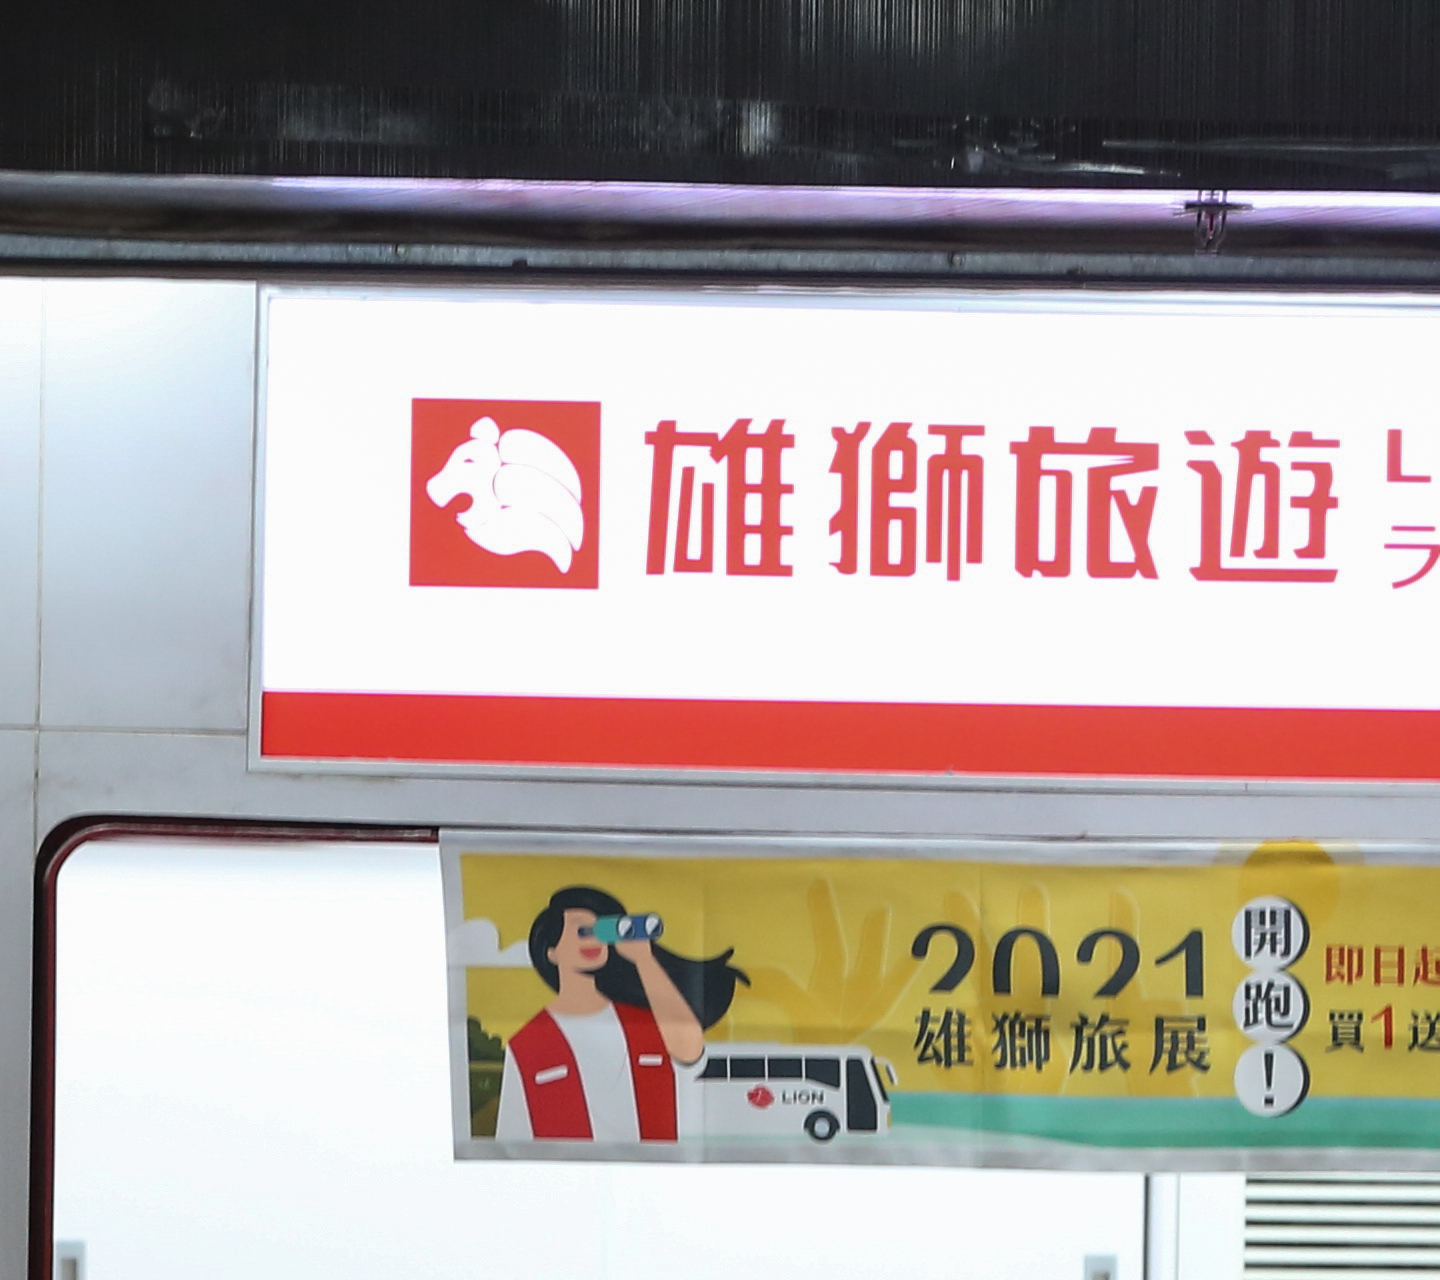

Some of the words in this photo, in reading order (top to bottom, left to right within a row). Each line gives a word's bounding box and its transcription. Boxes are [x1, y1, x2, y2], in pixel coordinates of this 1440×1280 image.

[644, 417, 1342, 586] 雄獅旅遊
[911, 922, 1205, 998] 2021
[913, 1008, 1211, 1074] 雄獅旅展
[781, 1089, 825, 1105] LION
